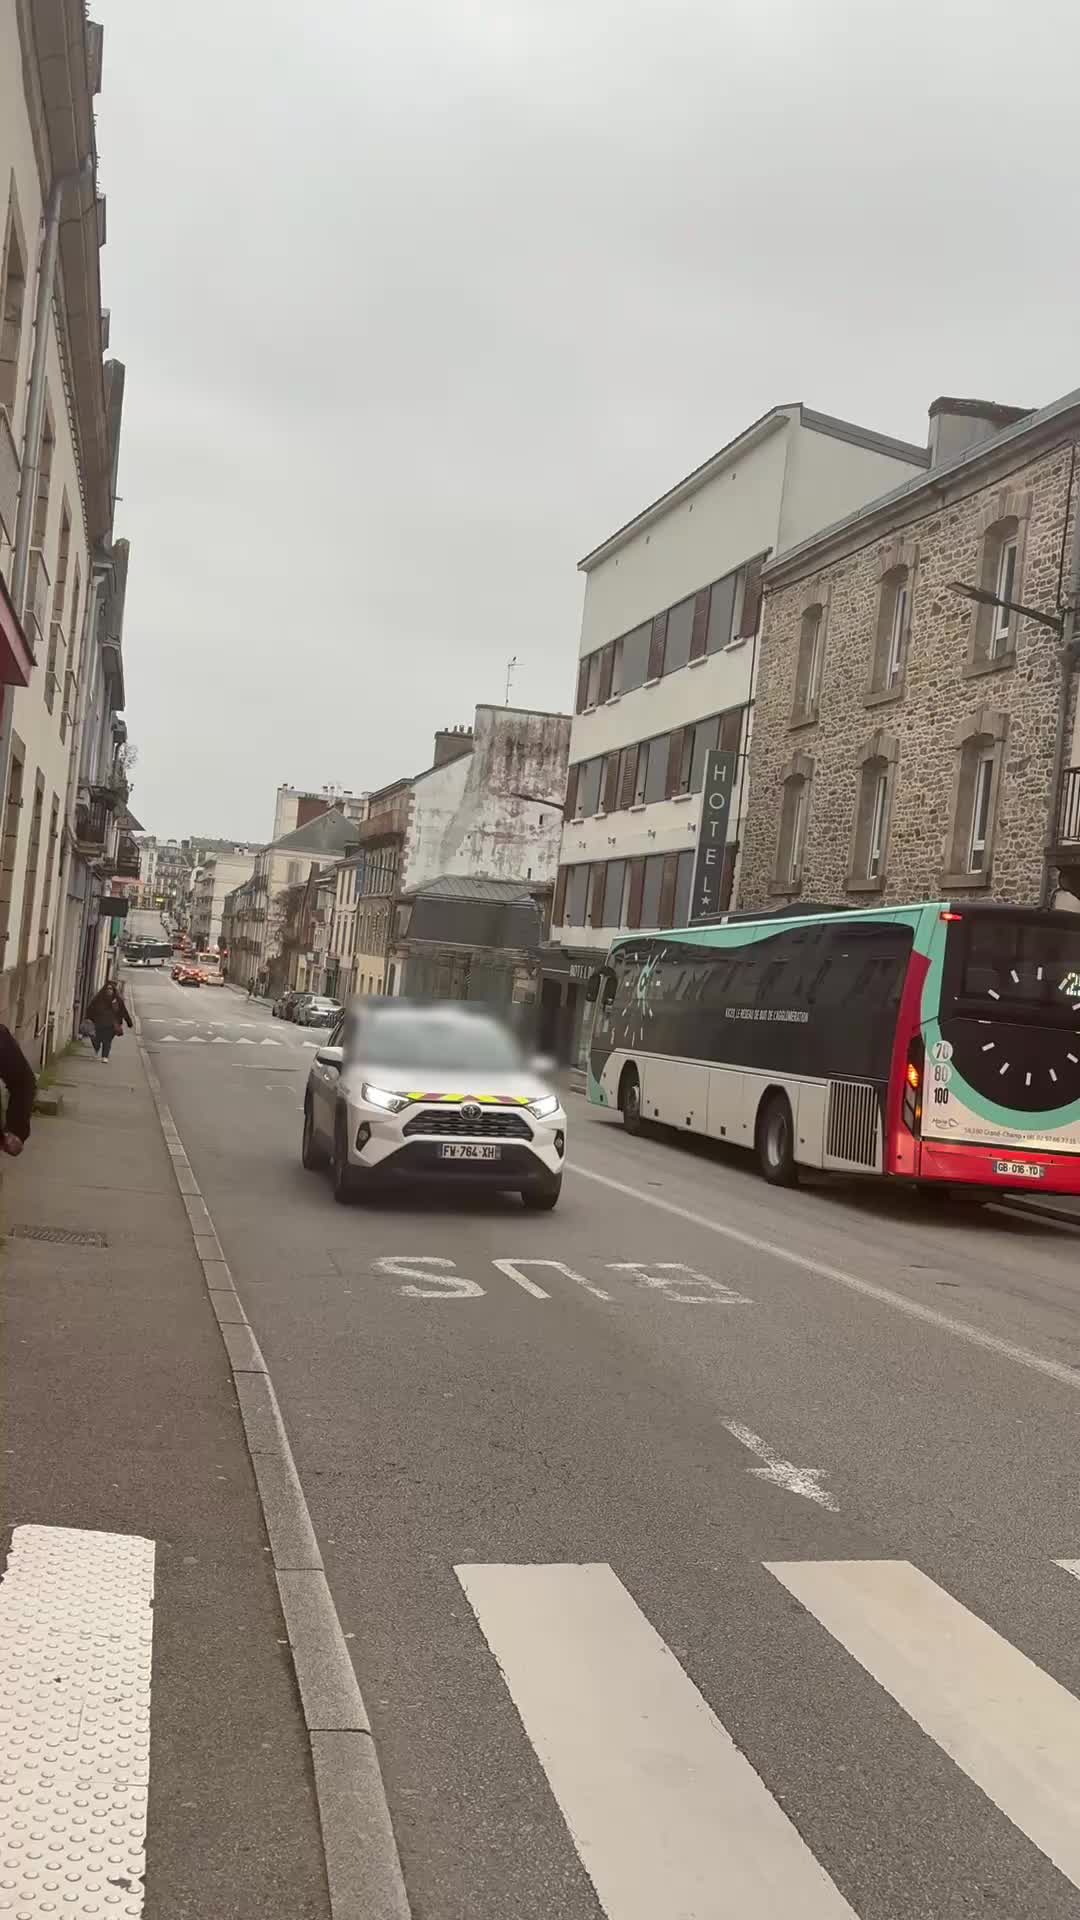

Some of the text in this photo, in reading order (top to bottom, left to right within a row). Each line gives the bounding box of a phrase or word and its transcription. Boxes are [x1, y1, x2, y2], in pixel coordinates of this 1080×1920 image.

[703, 764, 727, 893] HOTEL
[936, 1043, 949, 1059] 70
[935, 1065, 948, 1082] 80
[934, 1087, 949, 1104] 100
[371, 1256, 754, 1303] BUS
